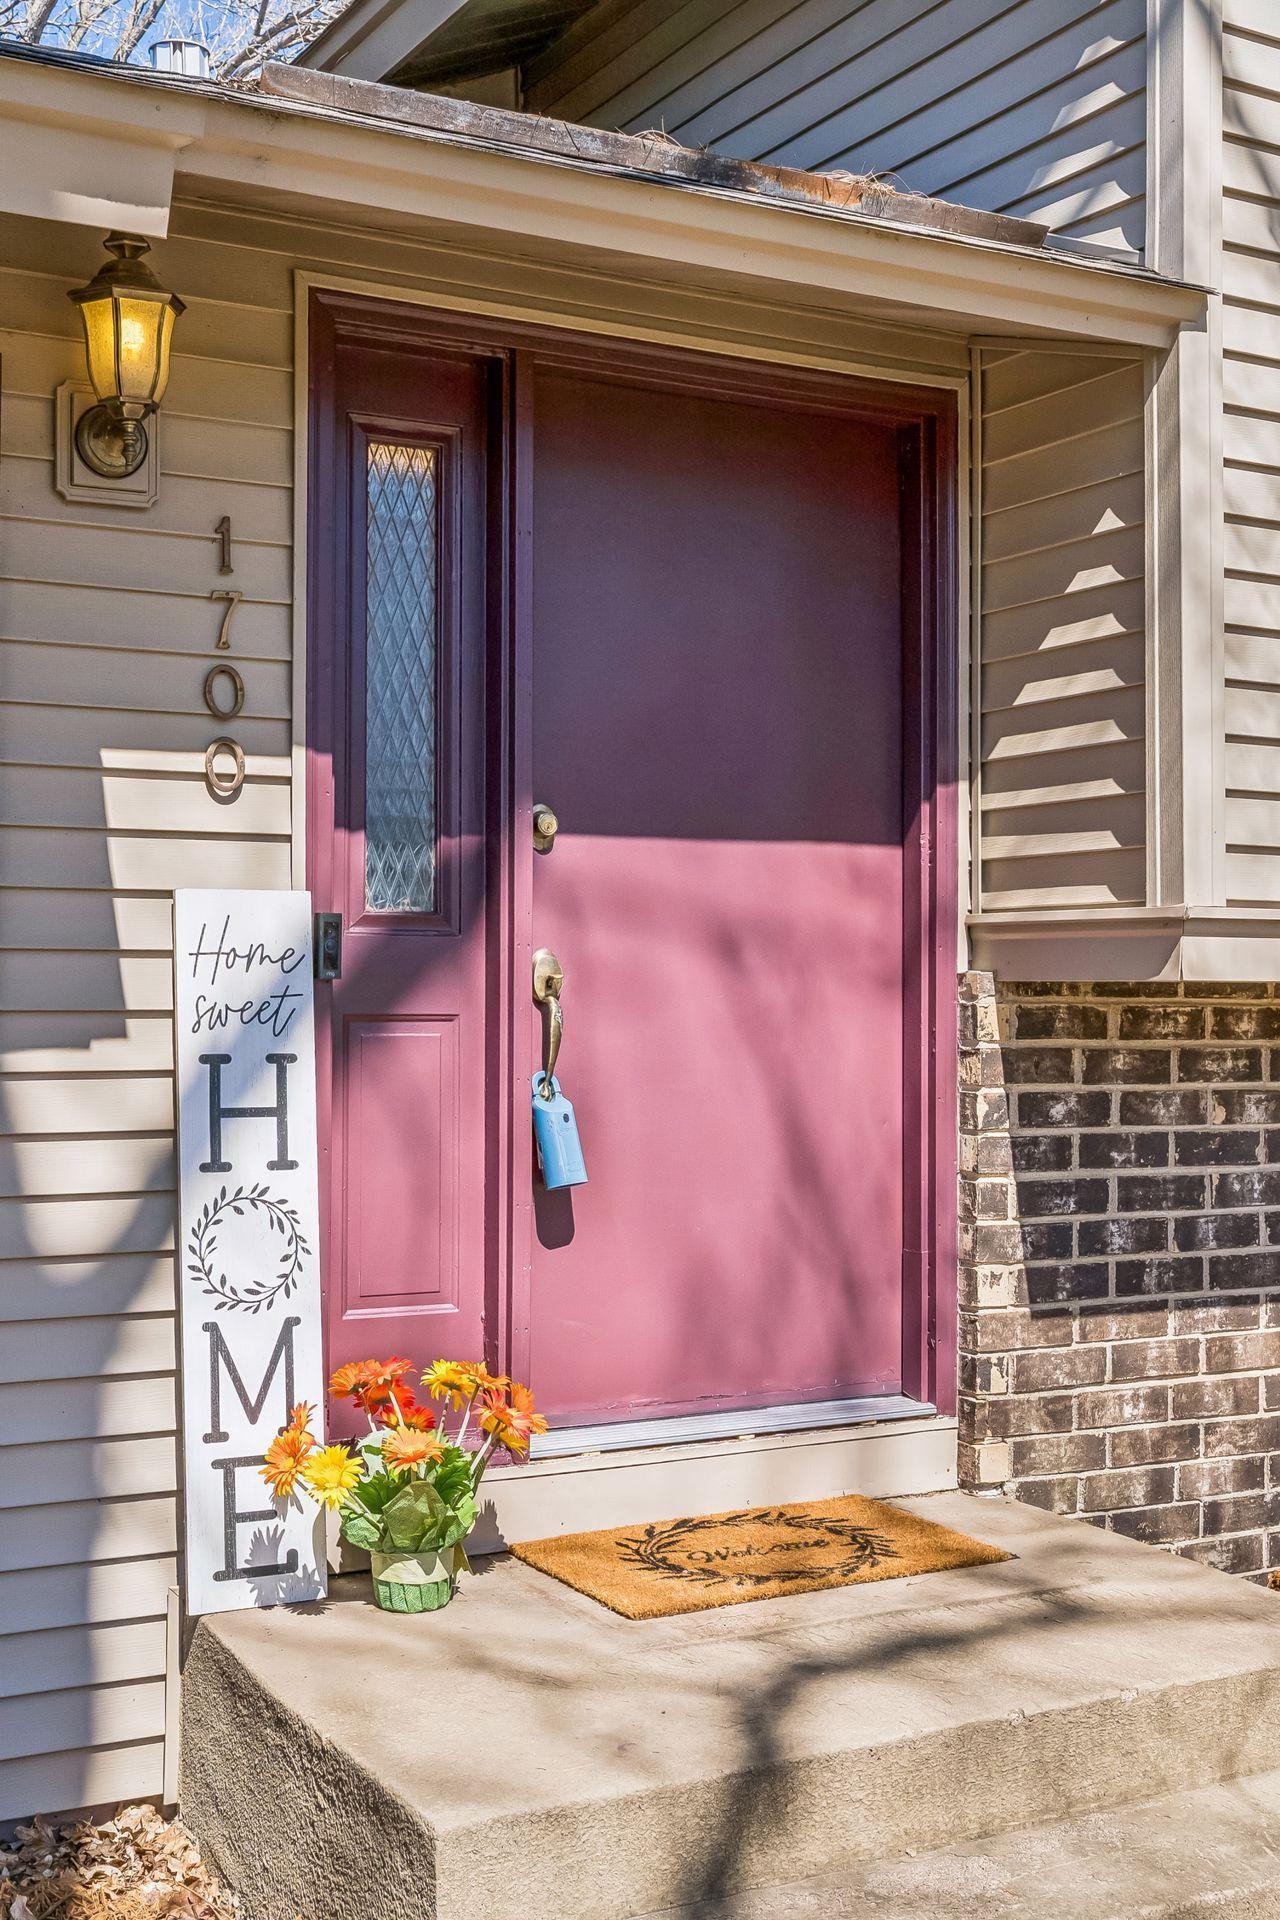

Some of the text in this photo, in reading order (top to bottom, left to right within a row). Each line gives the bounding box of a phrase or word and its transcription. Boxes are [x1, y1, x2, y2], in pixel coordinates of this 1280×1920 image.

[203, 515, 246, 793] 1700
[188, 914, 306, 986] Home
[191, 985, 303, 1037] sweet
